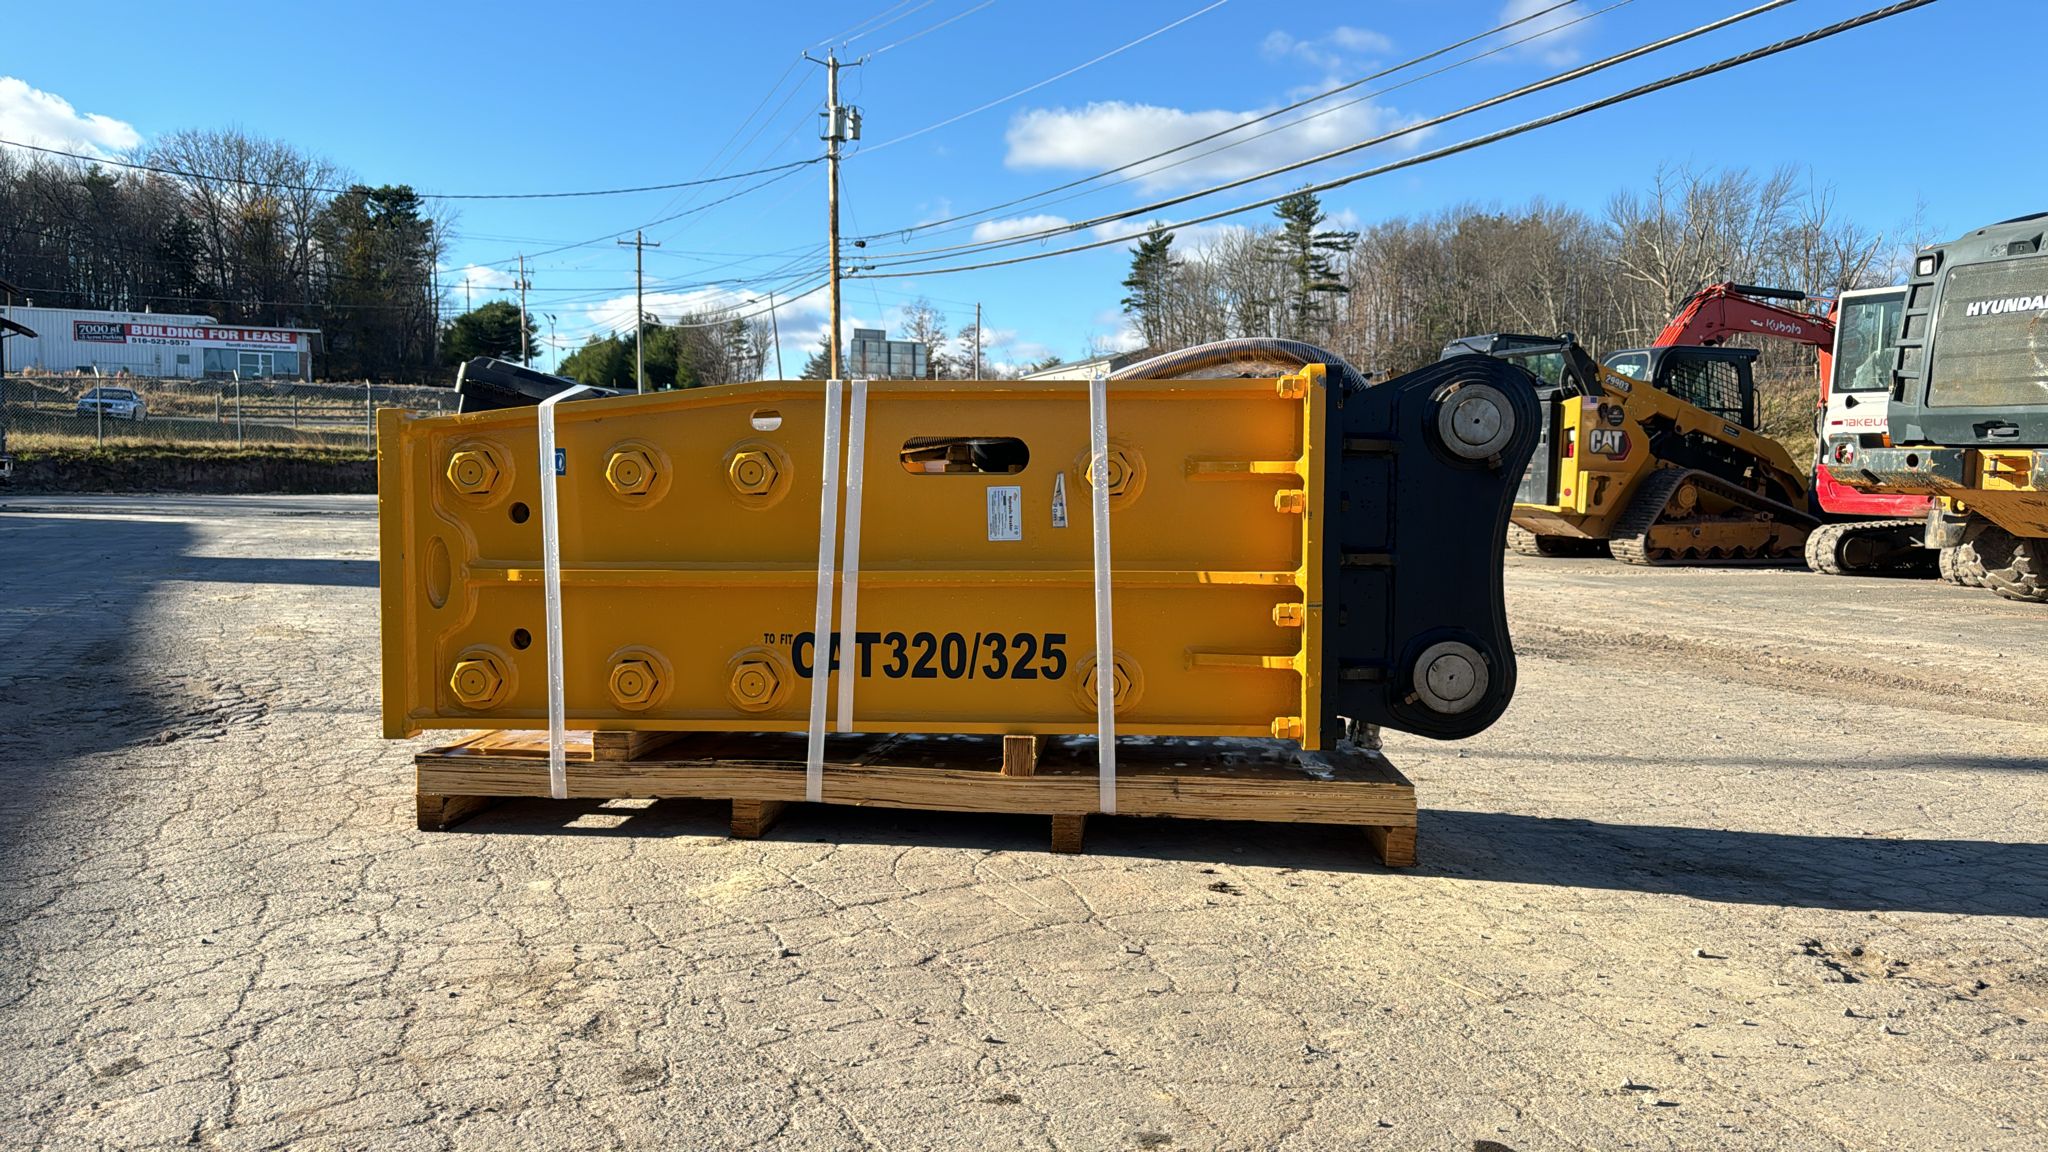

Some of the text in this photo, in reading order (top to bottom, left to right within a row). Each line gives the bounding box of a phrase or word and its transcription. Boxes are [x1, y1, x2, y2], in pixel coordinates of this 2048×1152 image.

[79, 325, 108, 333] 7000
[131, 325, 291, 342] BUILDING FOR LEASE
[1766, 319, 1801, 334] Kubota
[1605, 374, 1629, 391] 29903
[1590, 430, 1622, 453] CAT
[764, 632, 775, 644] TO
[780, 633, 793, 645] FIT
